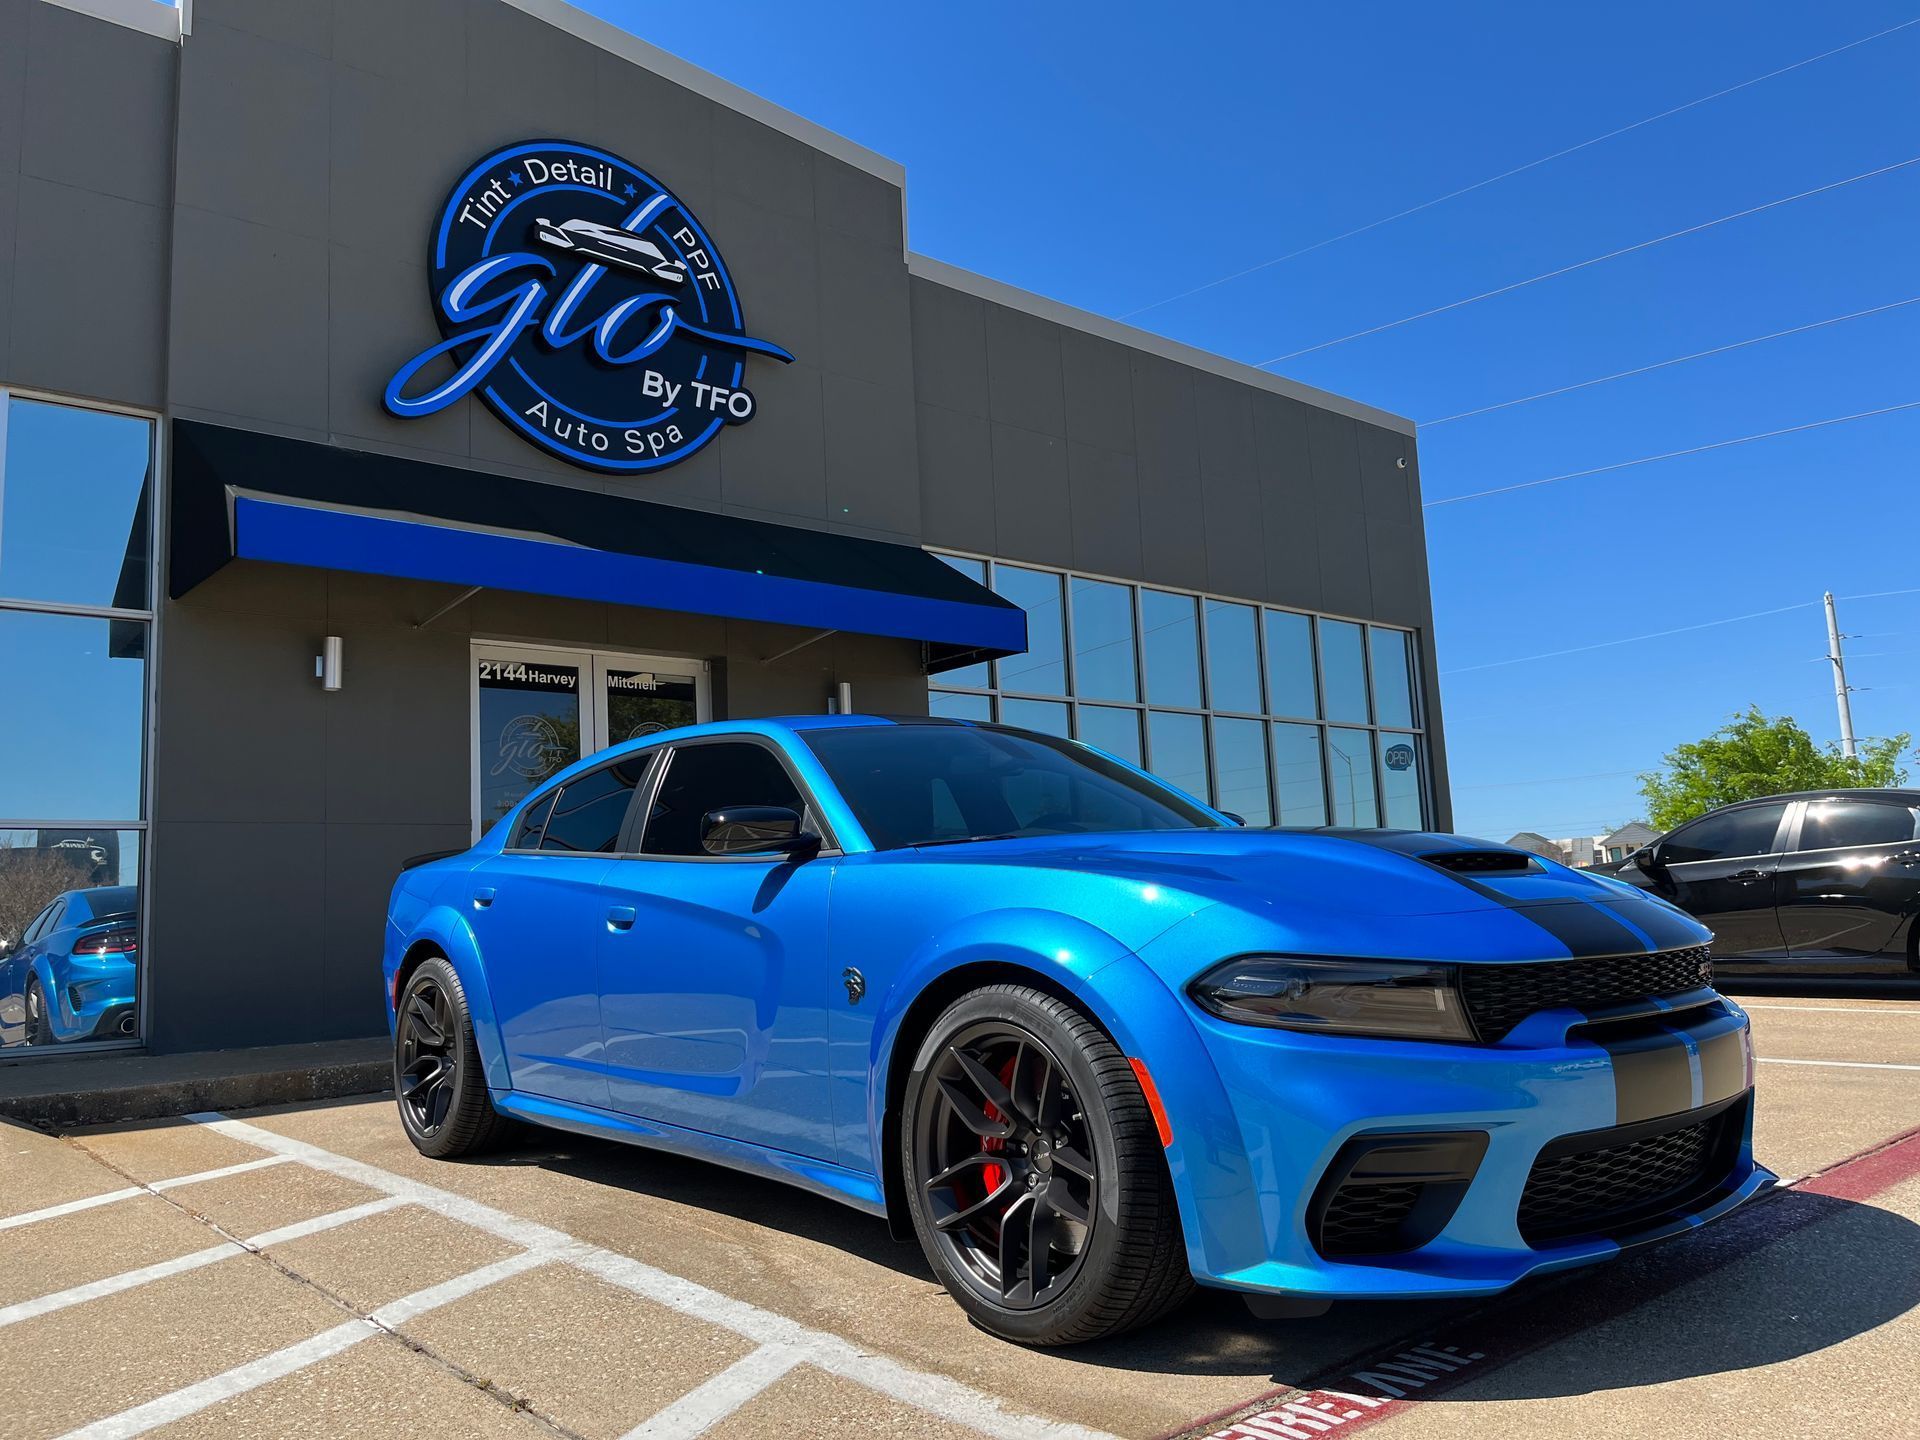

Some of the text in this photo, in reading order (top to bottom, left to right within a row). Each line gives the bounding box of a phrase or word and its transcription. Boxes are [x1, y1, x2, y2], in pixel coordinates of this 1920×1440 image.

[458, 158, 721, 291] Tint Detail PPF
[381, 193, 797, 419] glo
[641, 370, 753, 419] By TFO
[524, 401, 684, 458] Auto Spa
[479, 662, 657, 691] 2144 Harvey Mitchell
[1386, 751, 1412, 766] OPEN
[1315, 1342, 1486, 1408] LANE
